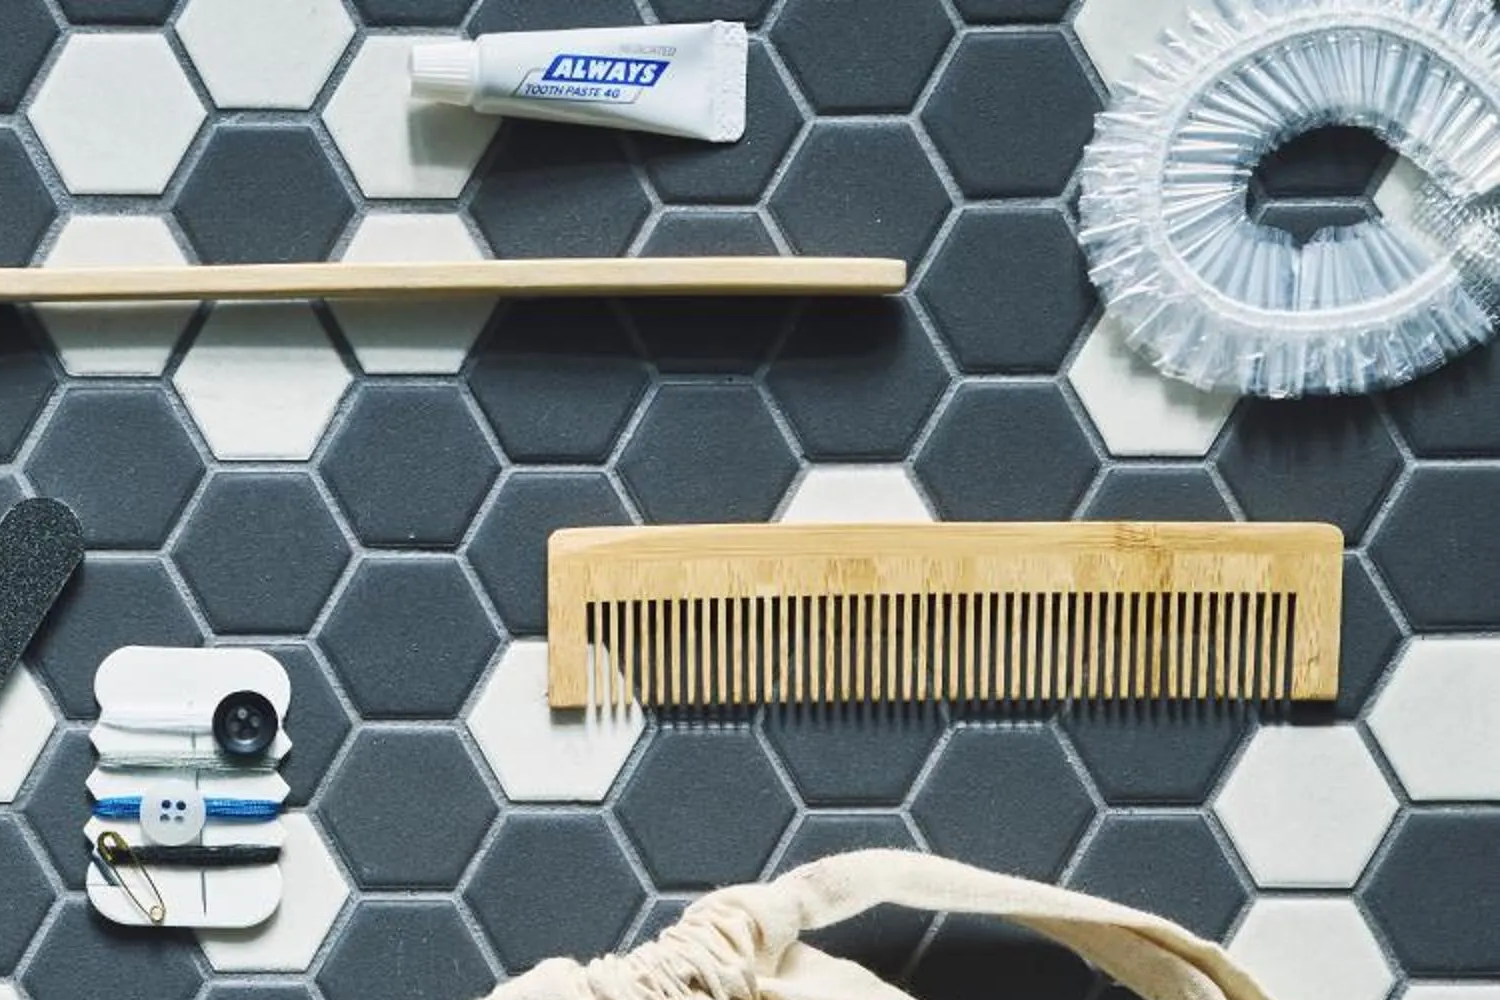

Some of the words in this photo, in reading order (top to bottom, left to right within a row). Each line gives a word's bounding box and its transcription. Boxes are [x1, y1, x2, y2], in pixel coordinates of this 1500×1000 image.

[552, 57, 658, 83] ALWAYS
[525, 83, 563, 97] TOOTH
[565, 85, 602, 98] PASTE
